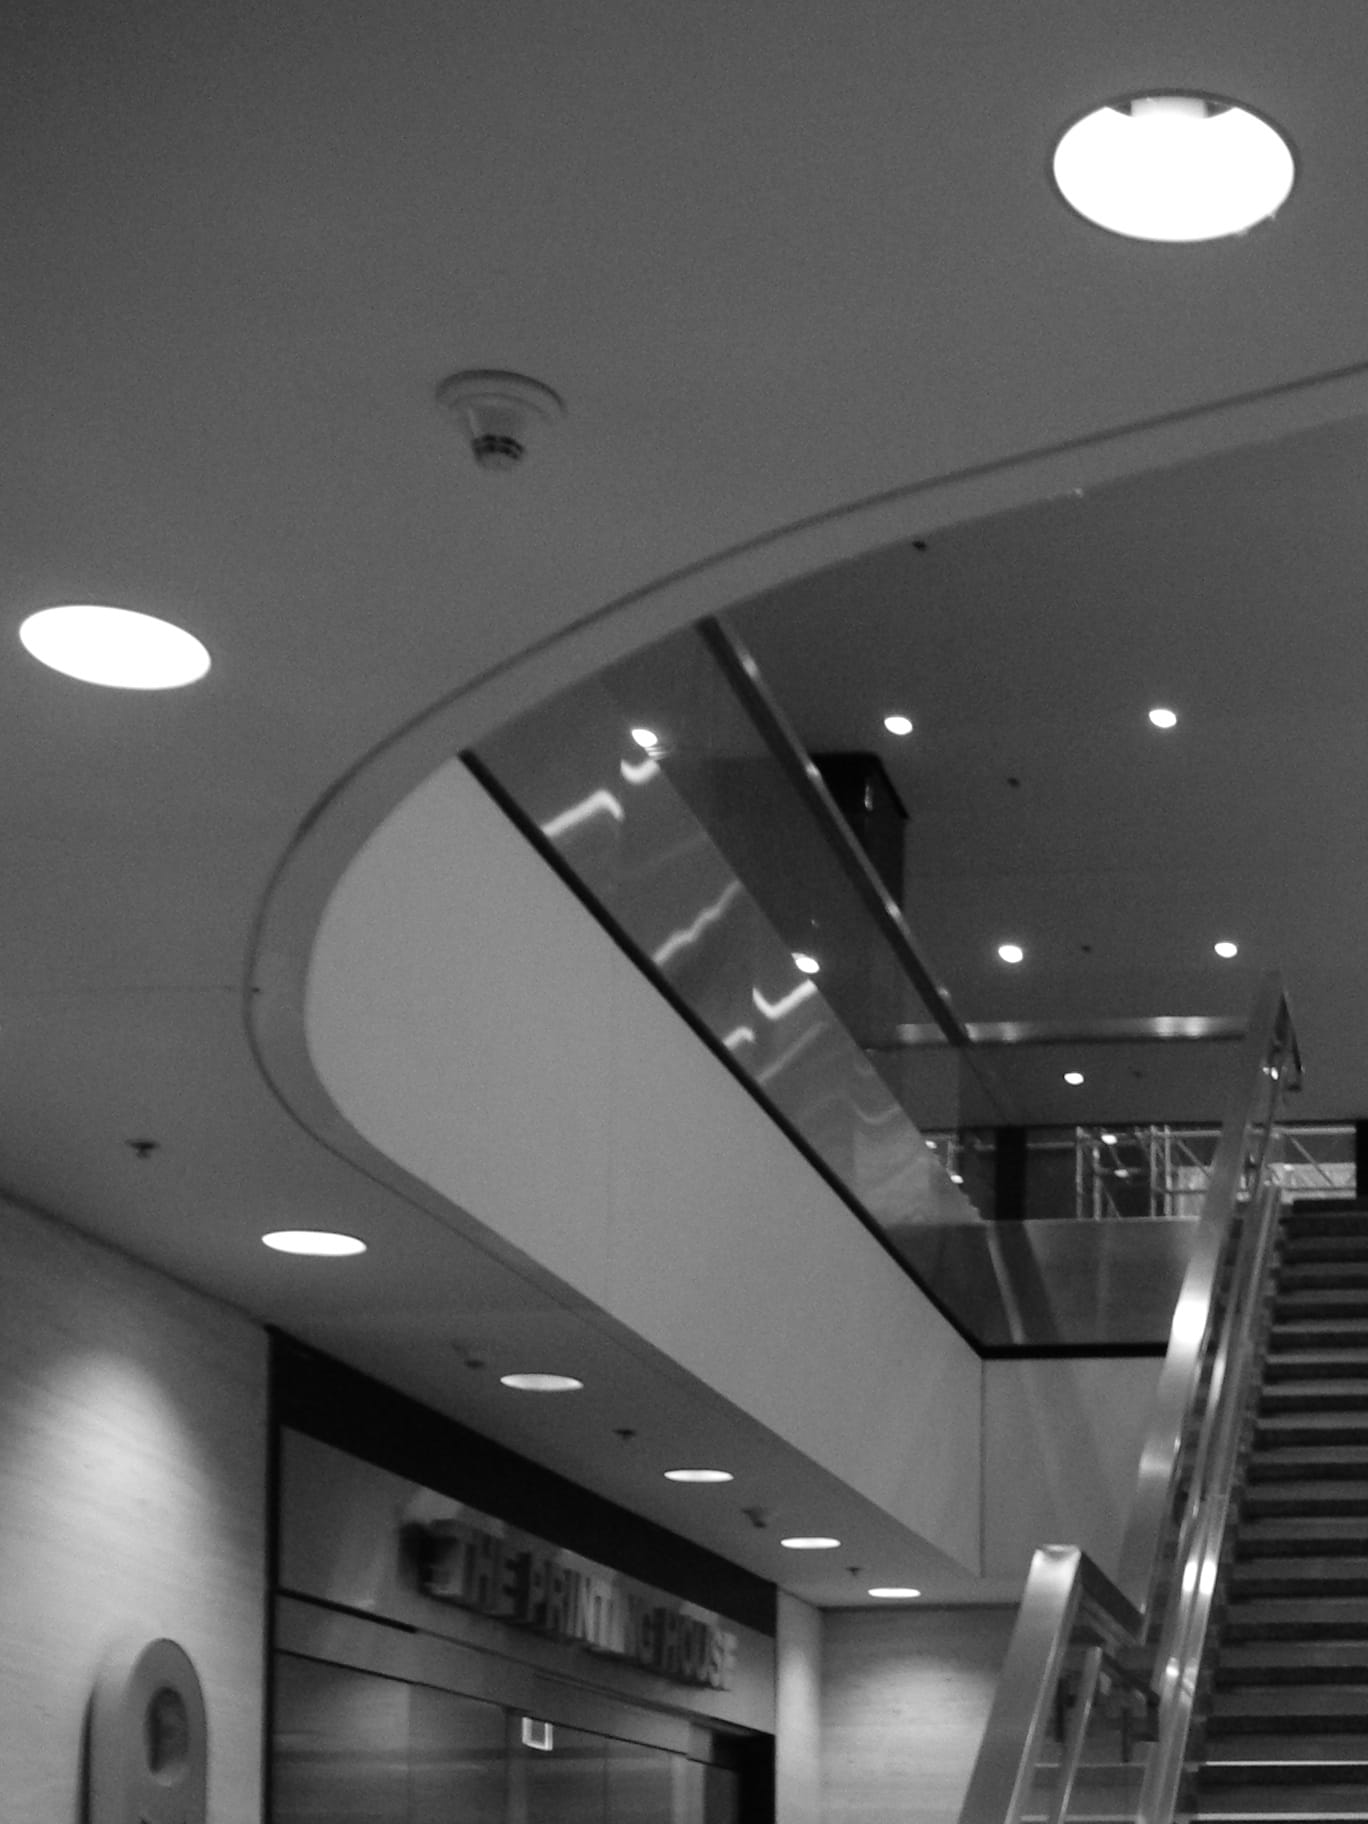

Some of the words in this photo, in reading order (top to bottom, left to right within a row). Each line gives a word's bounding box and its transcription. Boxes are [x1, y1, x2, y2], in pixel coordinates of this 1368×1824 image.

[454, 1528, 517, 1618] THE
[529, 1552, 654, 1666] PRINTING
[663, 1606, 738, 1690] HOUSE
